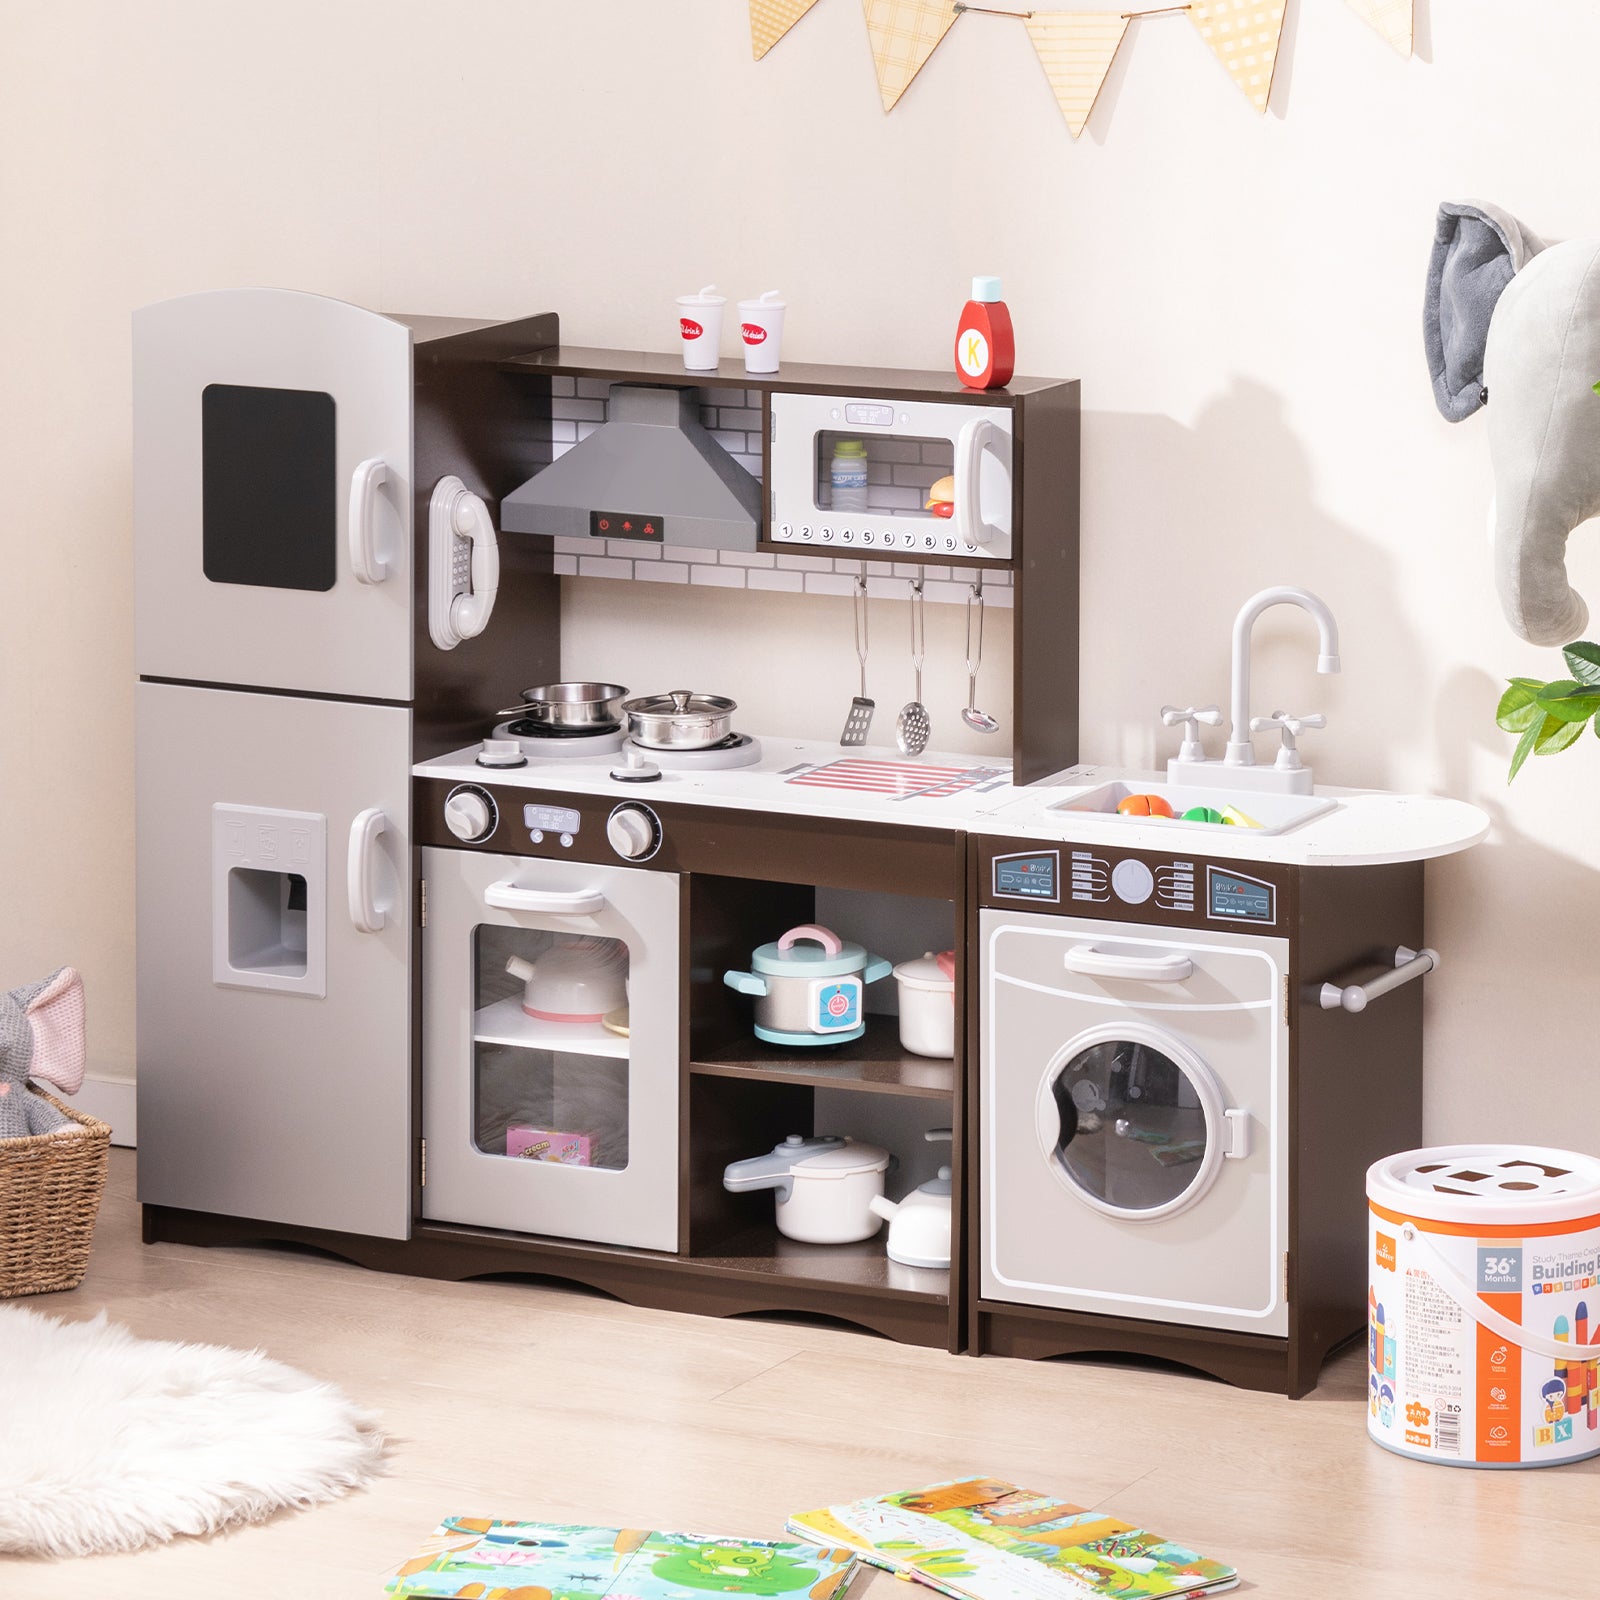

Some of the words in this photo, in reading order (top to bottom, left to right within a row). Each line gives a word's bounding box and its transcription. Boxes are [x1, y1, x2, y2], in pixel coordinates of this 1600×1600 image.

[967, 337, 980, 368] K
[803, 527, 809, 537] 2
[823, 529, 830, 539] 3
[843, 530, 850, 540] 4
[864, 532, 871, 542] 5
[884, 533, 891, 543] 6
[905, 535, 912, 545] 7
[925, 537, 932, 547] 8
[946, 538, 953, 548] 9
[1532, 1255, 1556, 1266] Study
[1532, 1259, 1595, 1281] Building
[1484, 1275, 1517, 1283] Months
[1538, 1428, 1551, 1442] B
[1556, 1423, 1568, 1440] X
